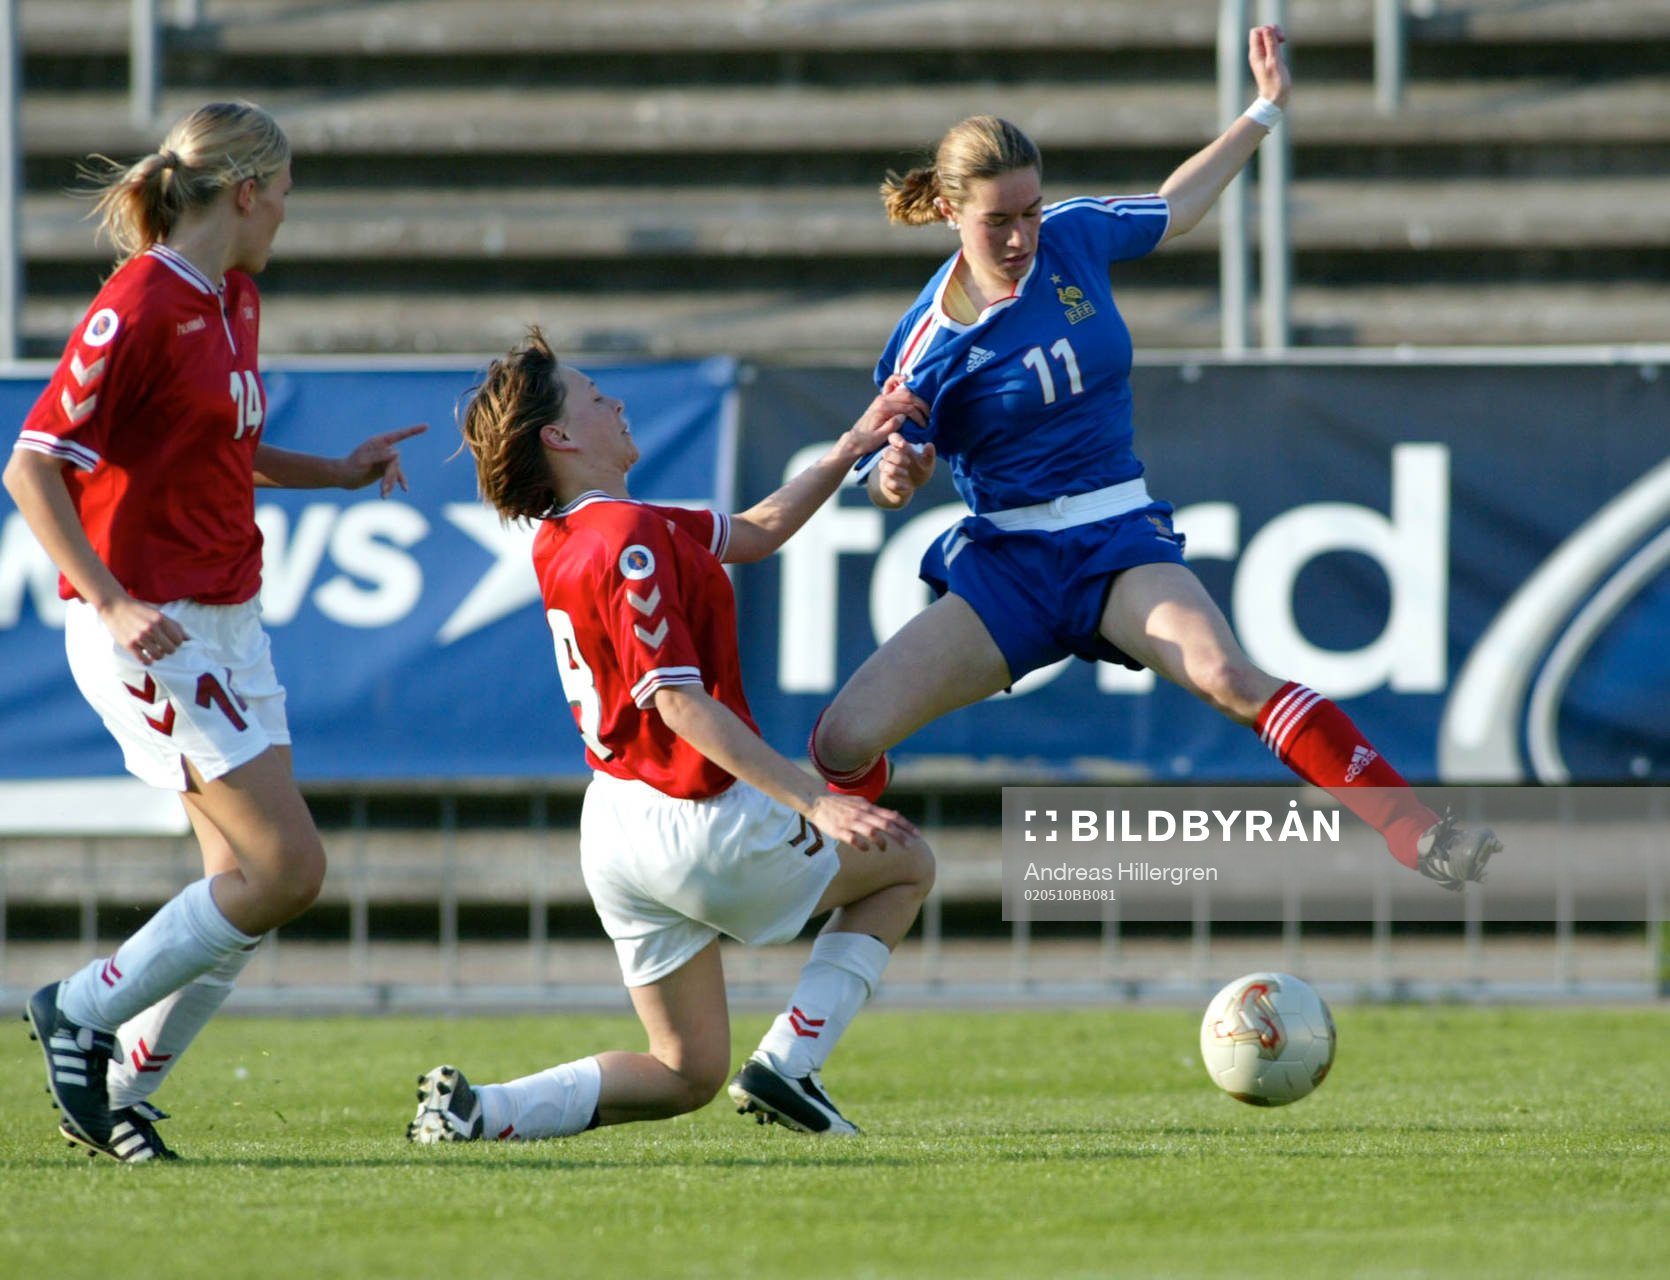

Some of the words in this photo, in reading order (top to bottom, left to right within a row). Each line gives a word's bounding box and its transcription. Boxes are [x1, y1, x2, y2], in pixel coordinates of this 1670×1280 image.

[966, 350, 996, 373] adidas
[1022, 337, 1084, 405] 11
[229, 369, 263, 440] 14
[195, 667, 249, 732] 1
[1344, 750, 1378, 784] adidas
